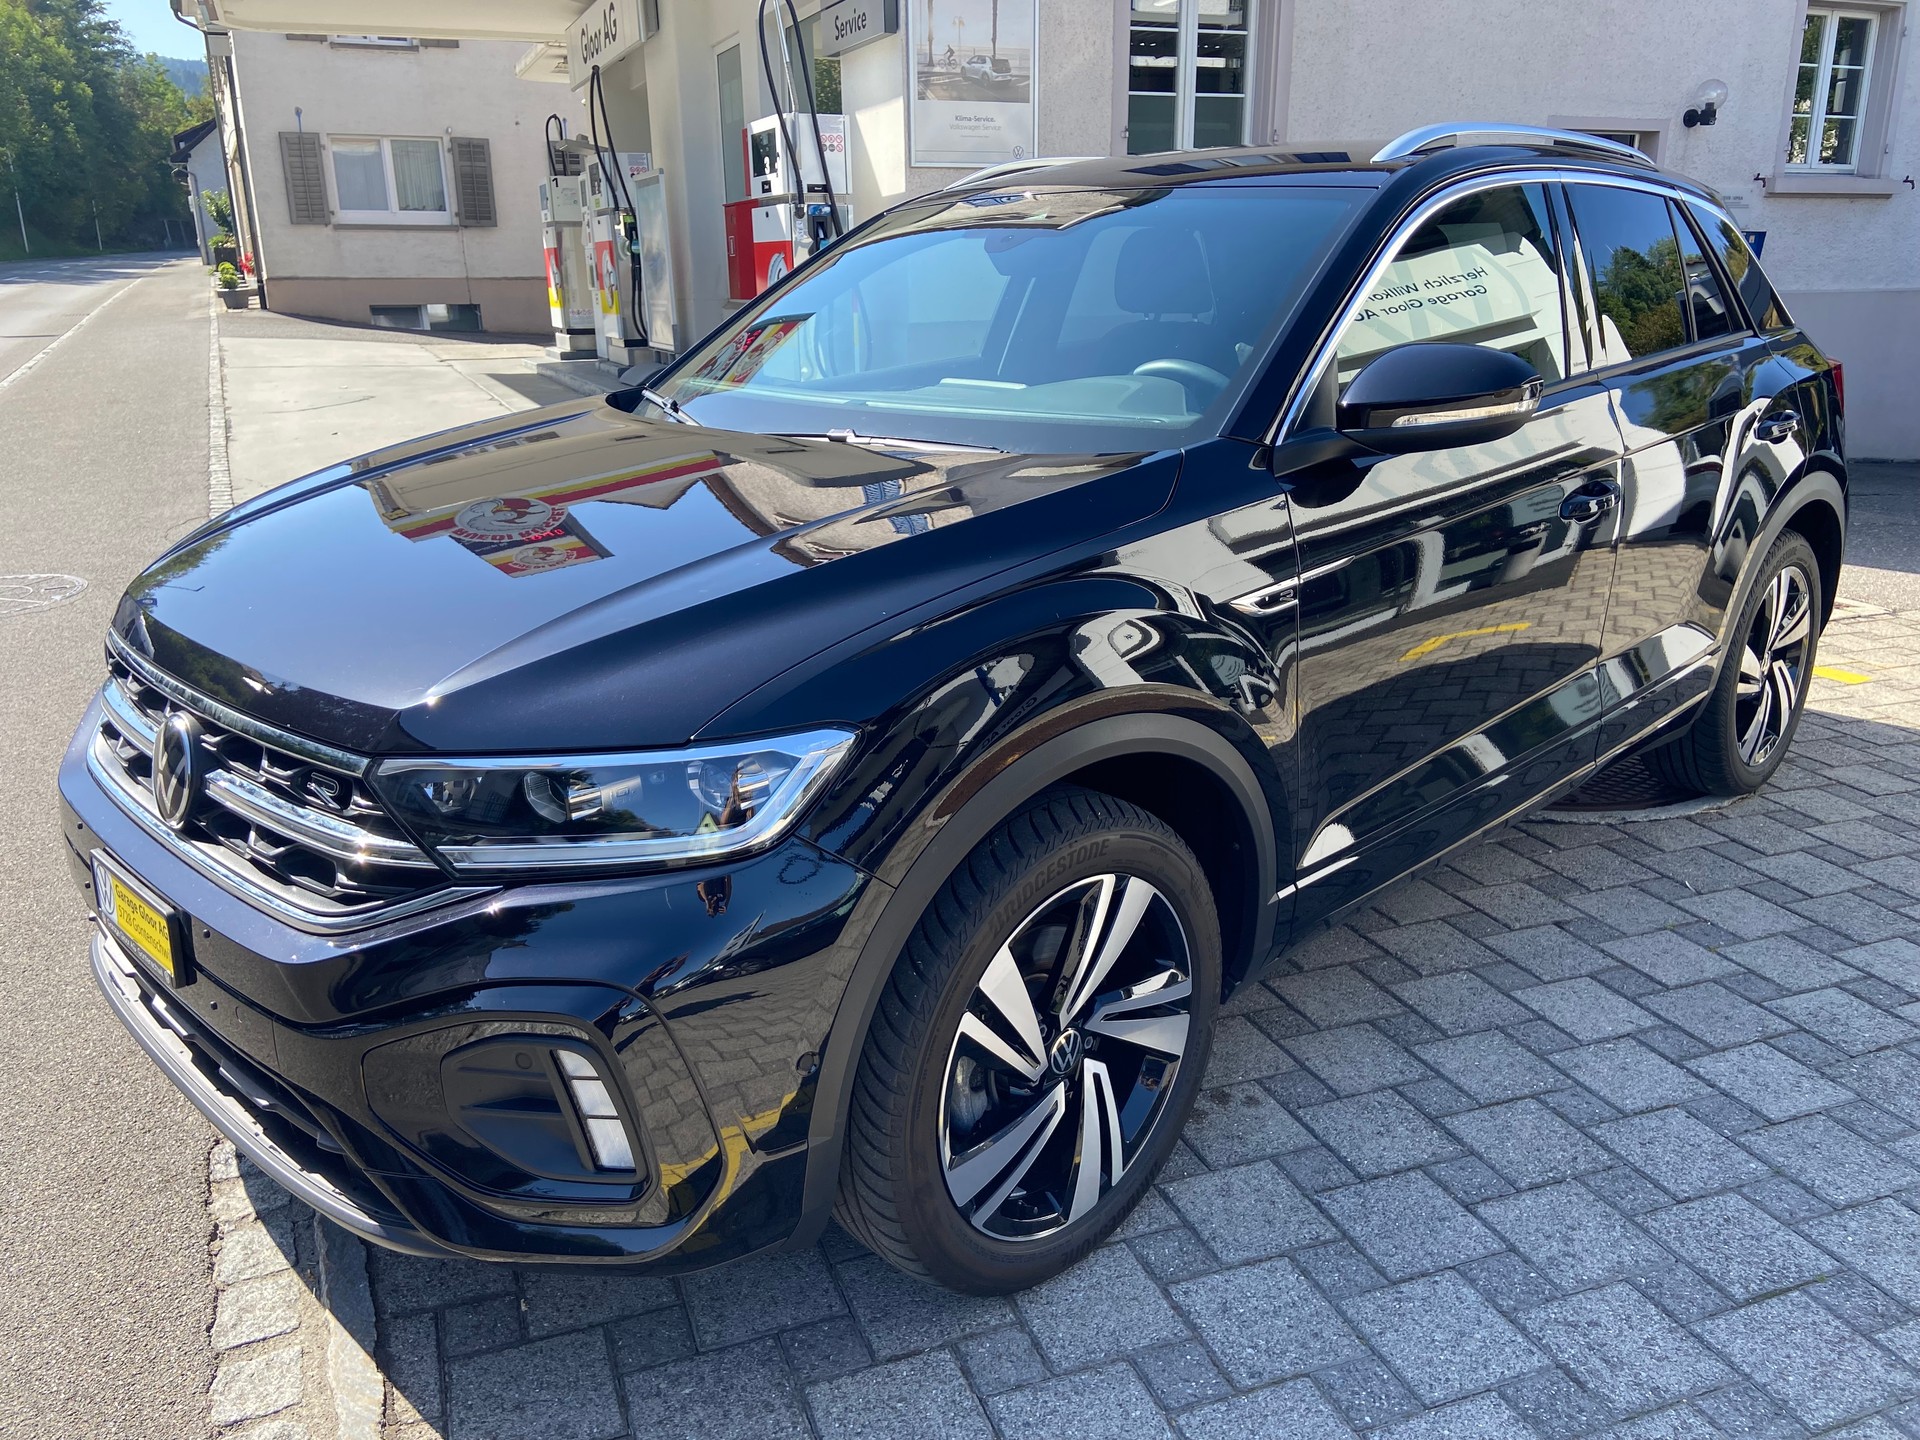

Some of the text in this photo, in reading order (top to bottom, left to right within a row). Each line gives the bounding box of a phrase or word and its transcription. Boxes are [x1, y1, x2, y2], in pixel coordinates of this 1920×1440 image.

[581, 2, 617, 64] Gloor AG
[835, 8, 867, 41] Service
[552, 178, 559, 188] 1
[115, 884, 138, 914] Garage
[139, 904, 157, 930] Gloor
[986, 839, 1110, 938] BRIDGESTONE
